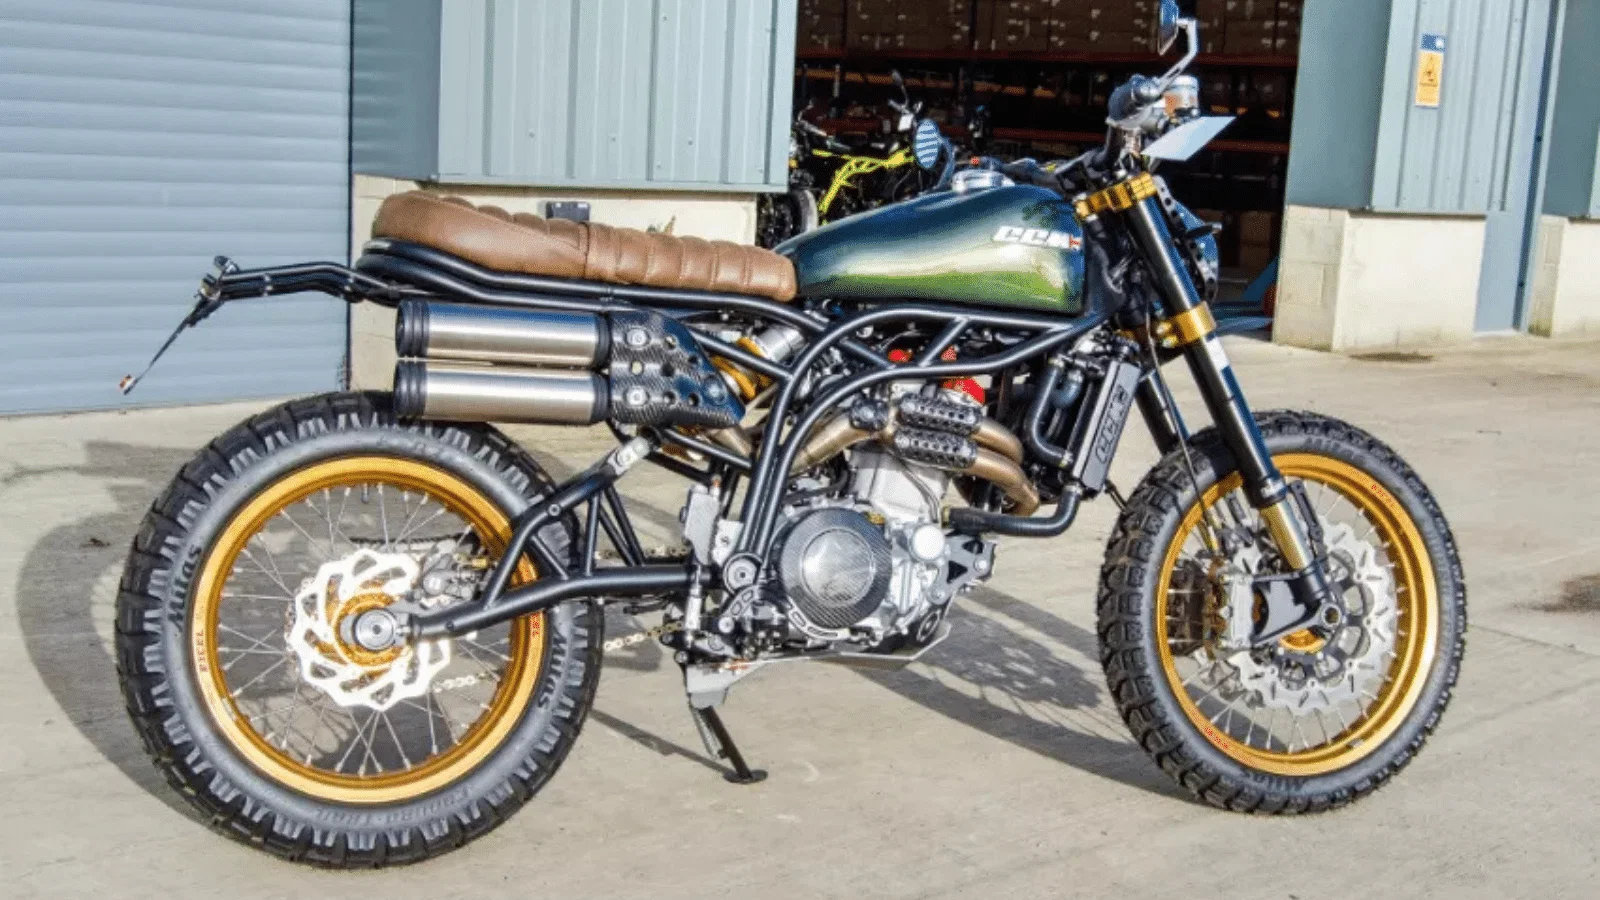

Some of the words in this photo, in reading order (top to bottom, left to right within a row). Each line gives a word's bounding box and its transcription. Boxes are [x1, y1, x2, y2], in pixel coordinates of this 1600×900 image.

[993, 225, 1073, 249] CCM
[168, 545, 202, 632] Mitas
[538, 624, 566, 707] Mitas
